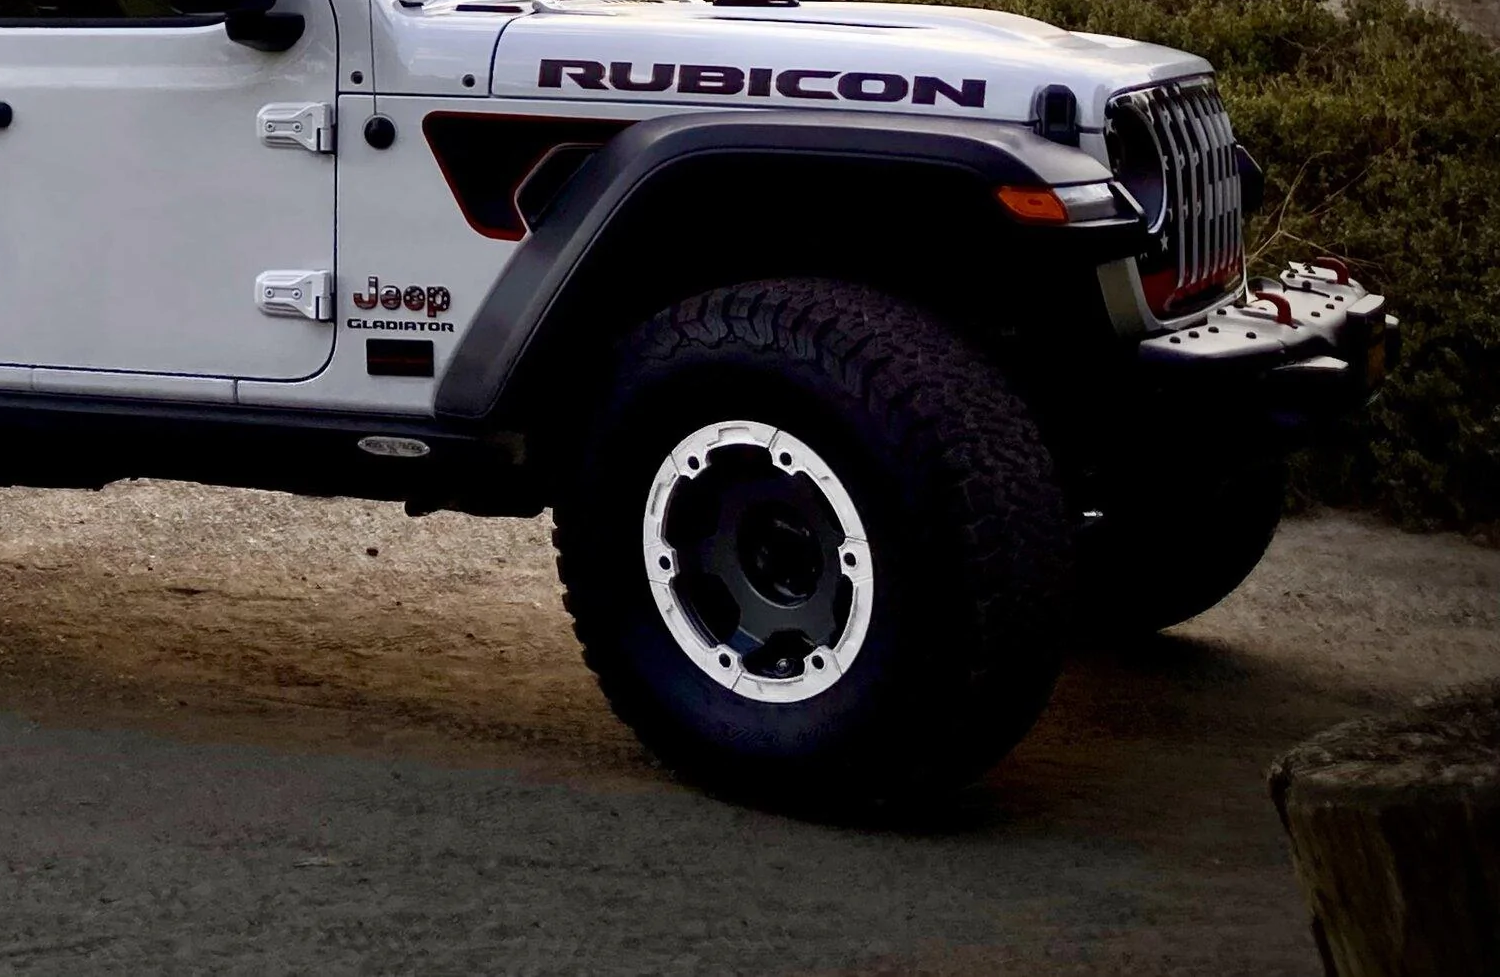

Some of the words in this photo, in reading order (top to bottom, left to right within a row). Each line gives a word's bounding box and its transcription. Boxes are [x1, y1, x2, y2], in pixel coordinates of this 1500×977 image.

[538, 59, 987, 108] RUBICON
[353, 276, 451, 317] Jeep
[347, 318, 454, 332] GLADIATOR
